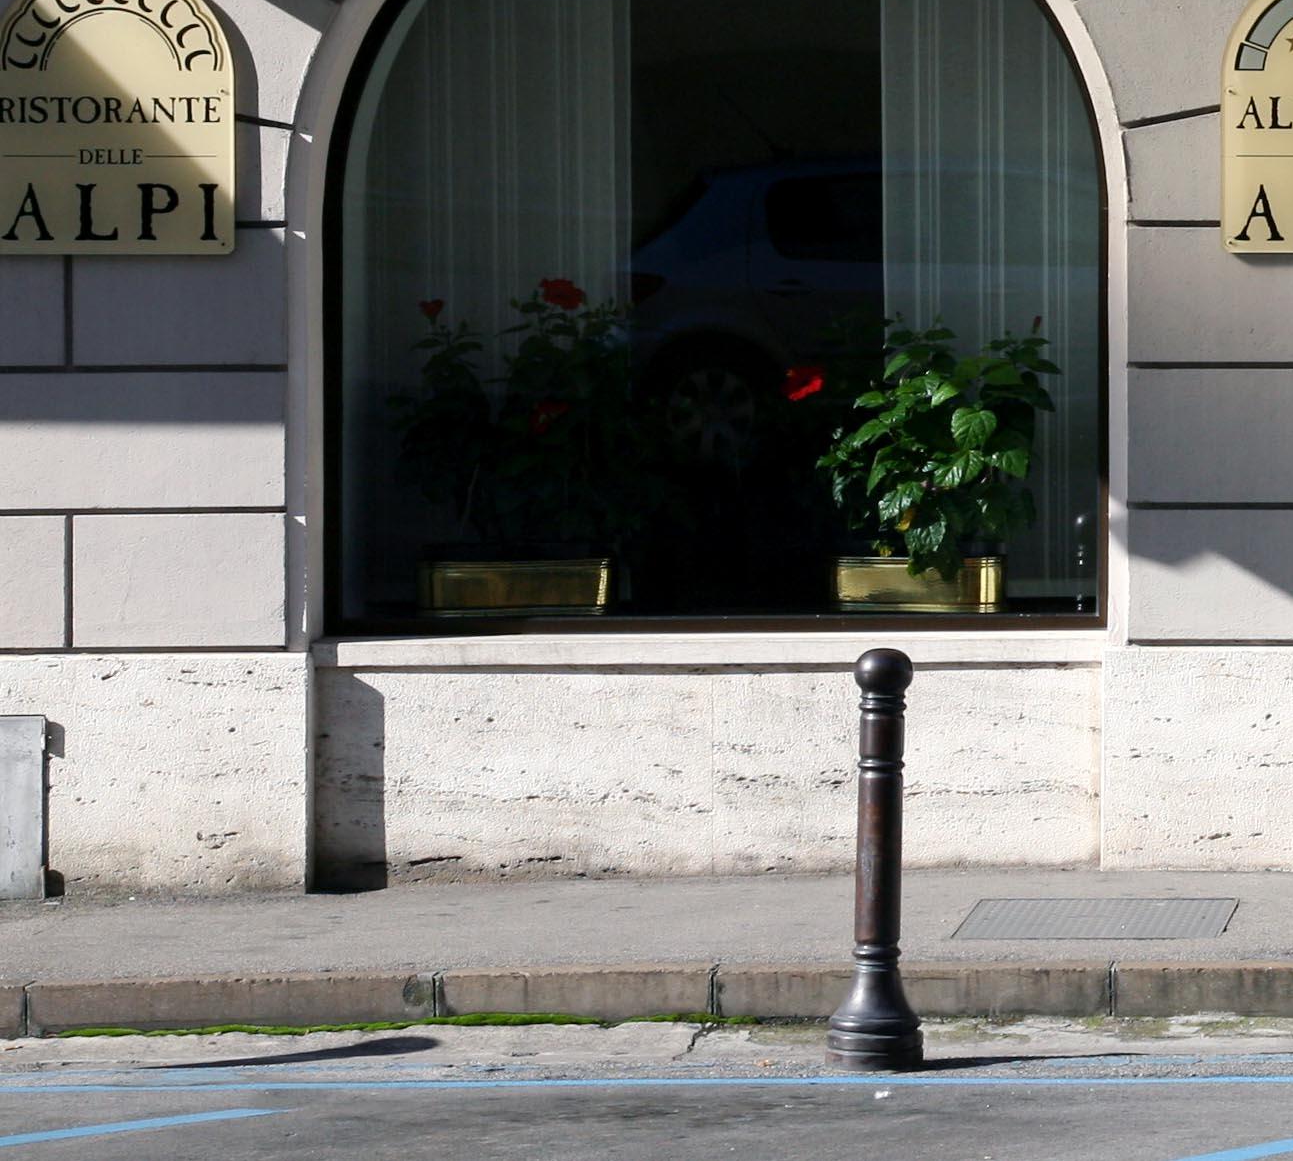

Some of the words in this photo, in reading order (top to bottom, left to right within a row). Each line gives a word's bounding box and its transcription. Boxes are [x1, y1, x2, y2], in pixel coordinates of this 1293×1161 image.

[0, 95, 222, 125] RISTORANTE
[78, 147, 144, 166] DELLE
[1, 181, 220, 242] ALPI
